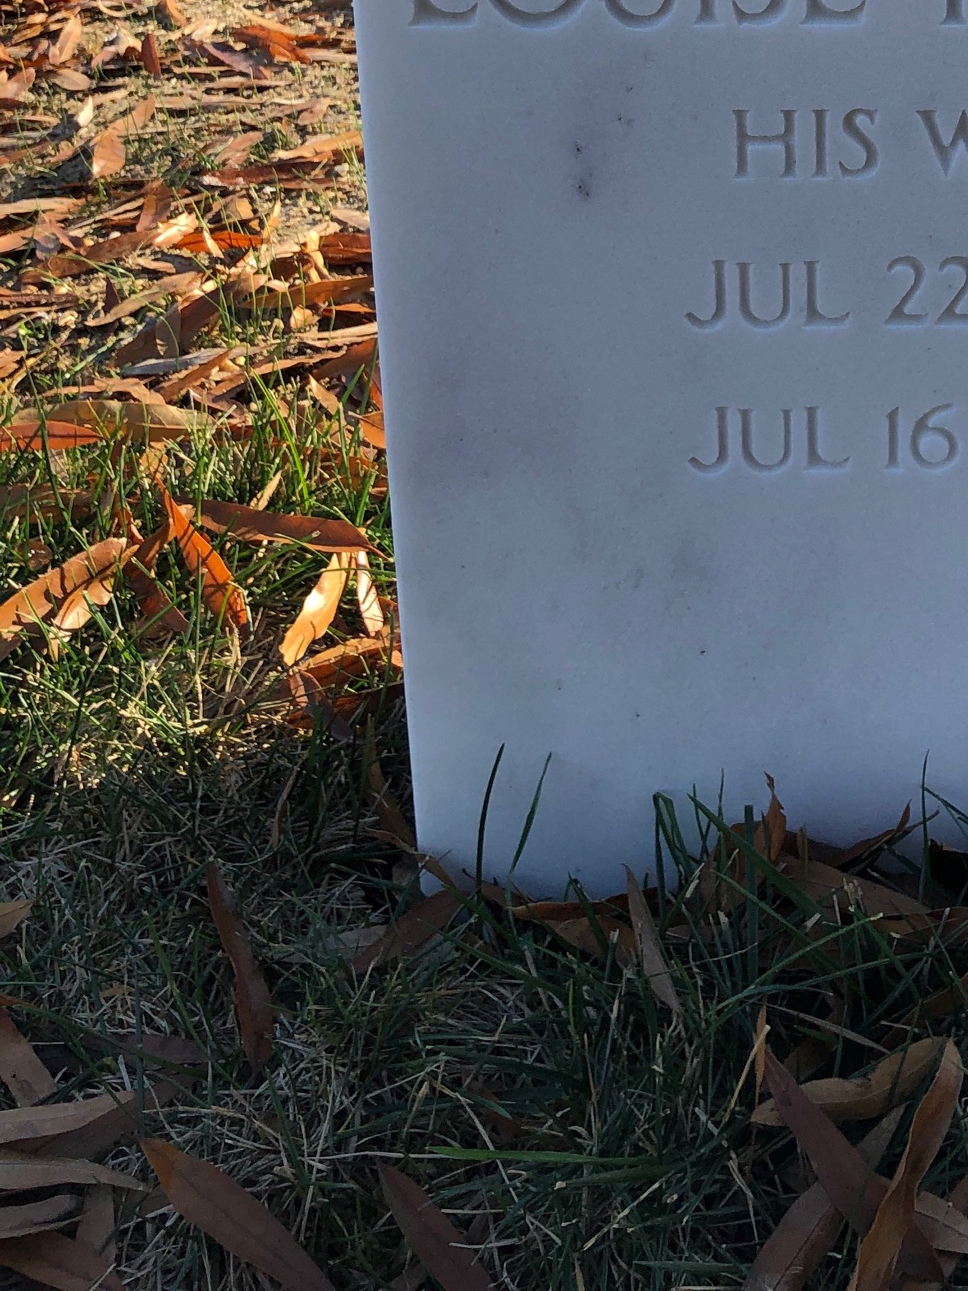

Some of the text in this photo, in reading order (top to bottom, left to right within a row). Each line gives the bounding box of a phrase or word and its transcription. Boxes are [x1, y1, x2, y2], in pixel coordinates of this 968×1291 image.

[731, 107, 880, 180] HIS
[684, 258, 852, 330] JUL
[688, 405, 852, 473] JUL
[884, 402, 959, 473] 16
